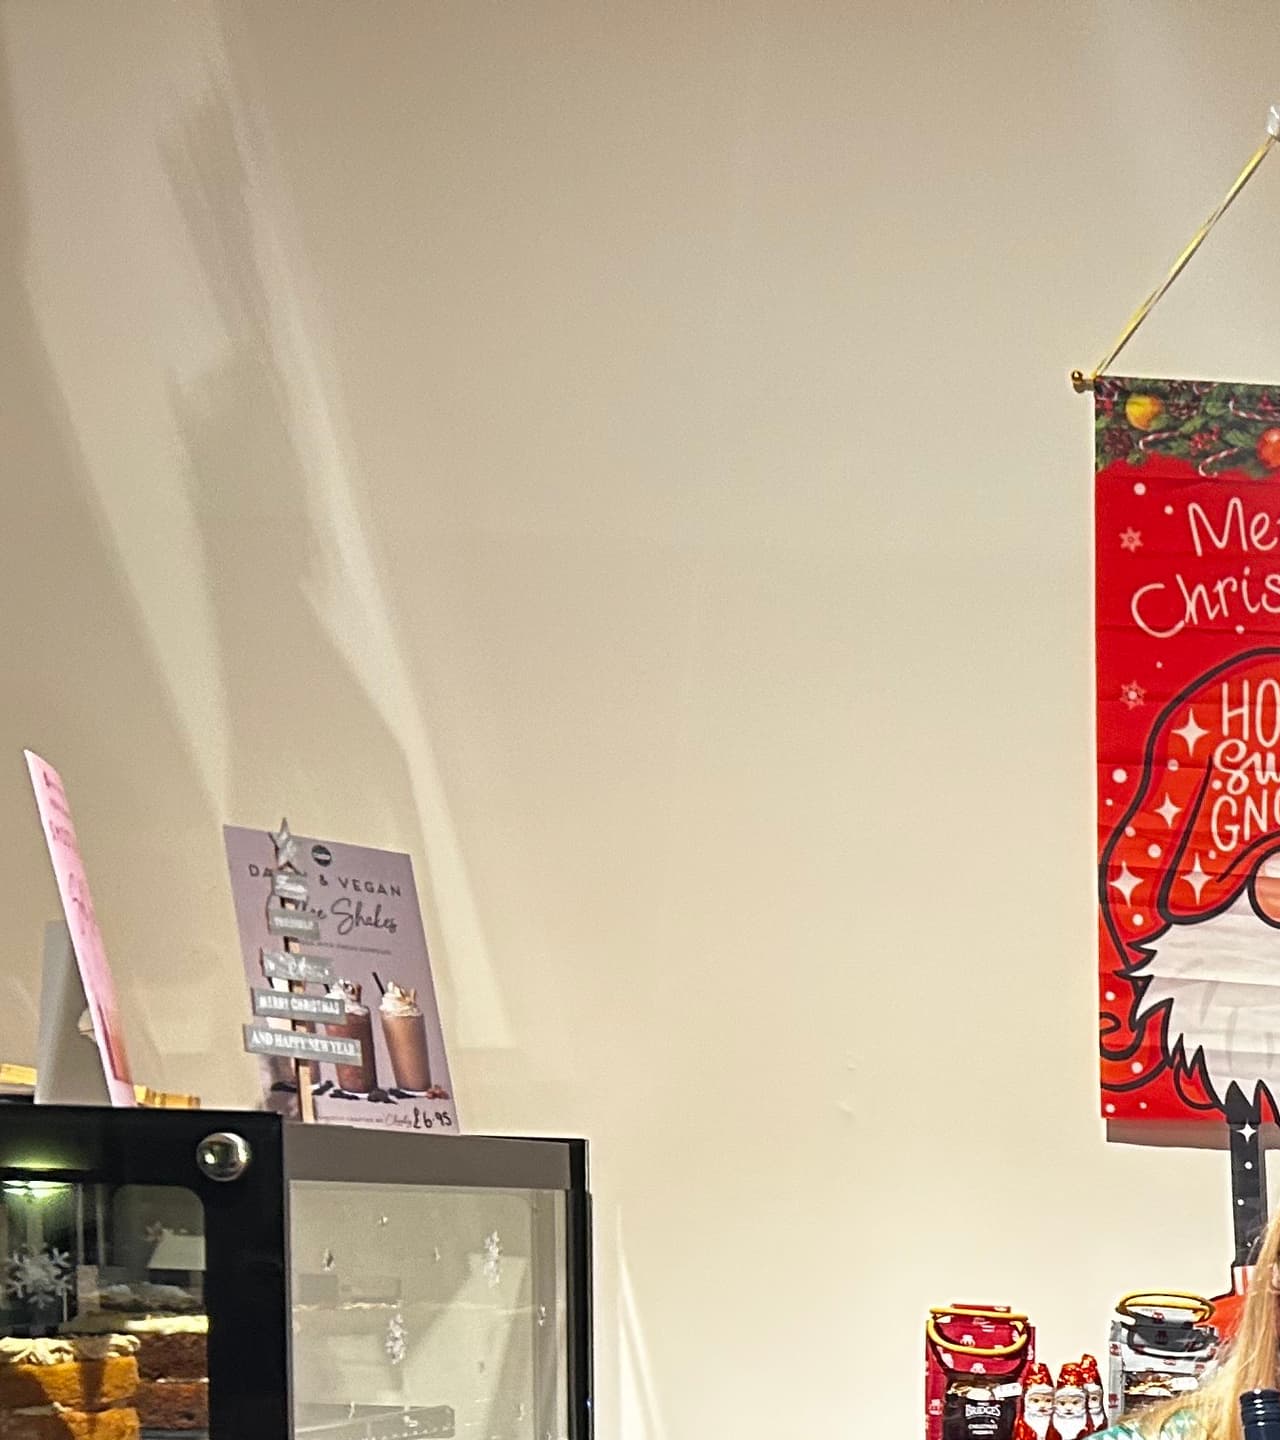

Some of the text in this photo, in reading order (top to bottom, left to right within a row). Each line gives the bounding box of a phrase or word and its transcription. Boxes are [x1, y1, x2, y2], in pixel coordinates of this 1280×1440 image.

[338, 877, 403, 897] VEGAN
[330, 897, 398, 936] Shakes
[251, 1031, 274, 1046] AND
[274, 1033, 307, 1050] HAPPY
[308, 1037, 330, 1053] NEW
